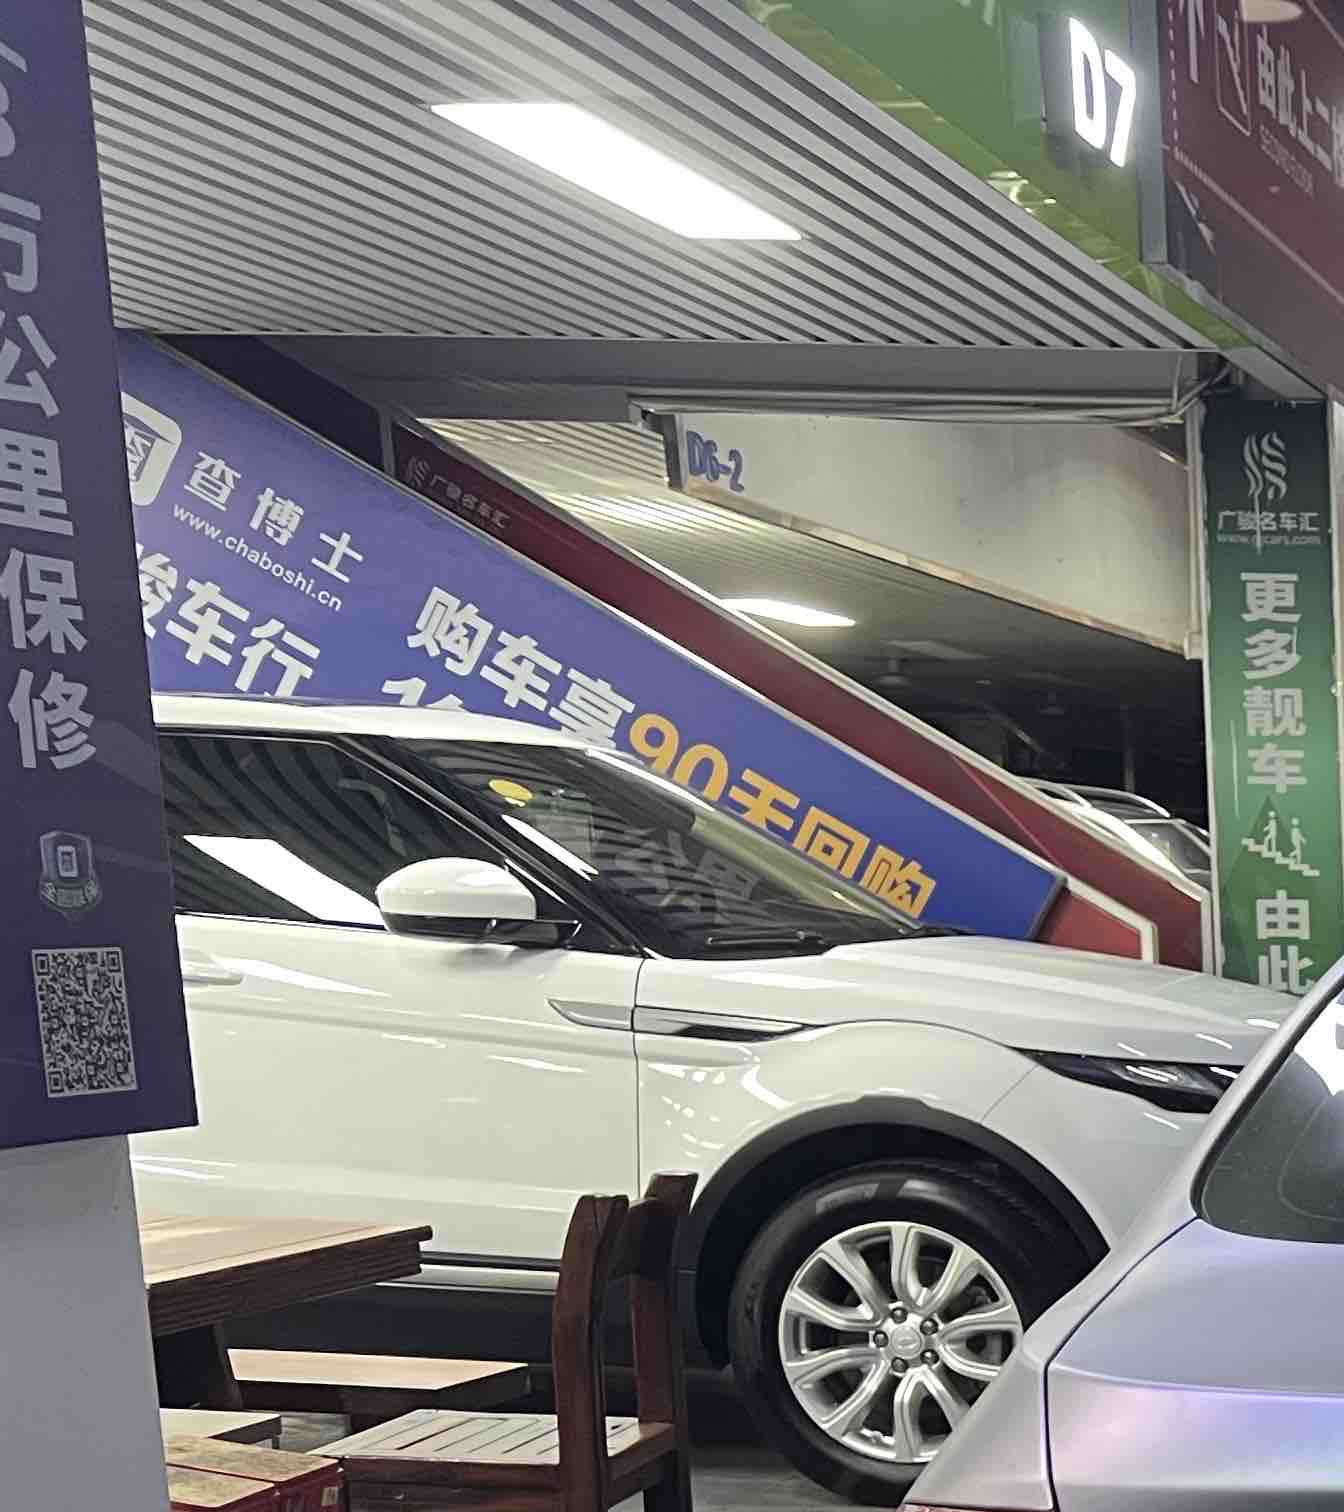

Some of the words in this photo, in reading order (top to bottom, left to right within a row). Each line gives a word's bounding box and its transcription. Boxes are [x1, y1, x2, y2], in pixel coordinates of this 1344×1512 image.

[1067, 16, 1138, 169] D7
[183, 450, 365, 584] 查博士
[686, 430, 745, 493] D6-2
[172, 502, 344, 613] www.chaboshi.cn
[1239, 571, 1308, 794] 更多靓车
[406, 584, 937, 920] 购车享90天回购
[1254, 889, 1318, 994] 由此
